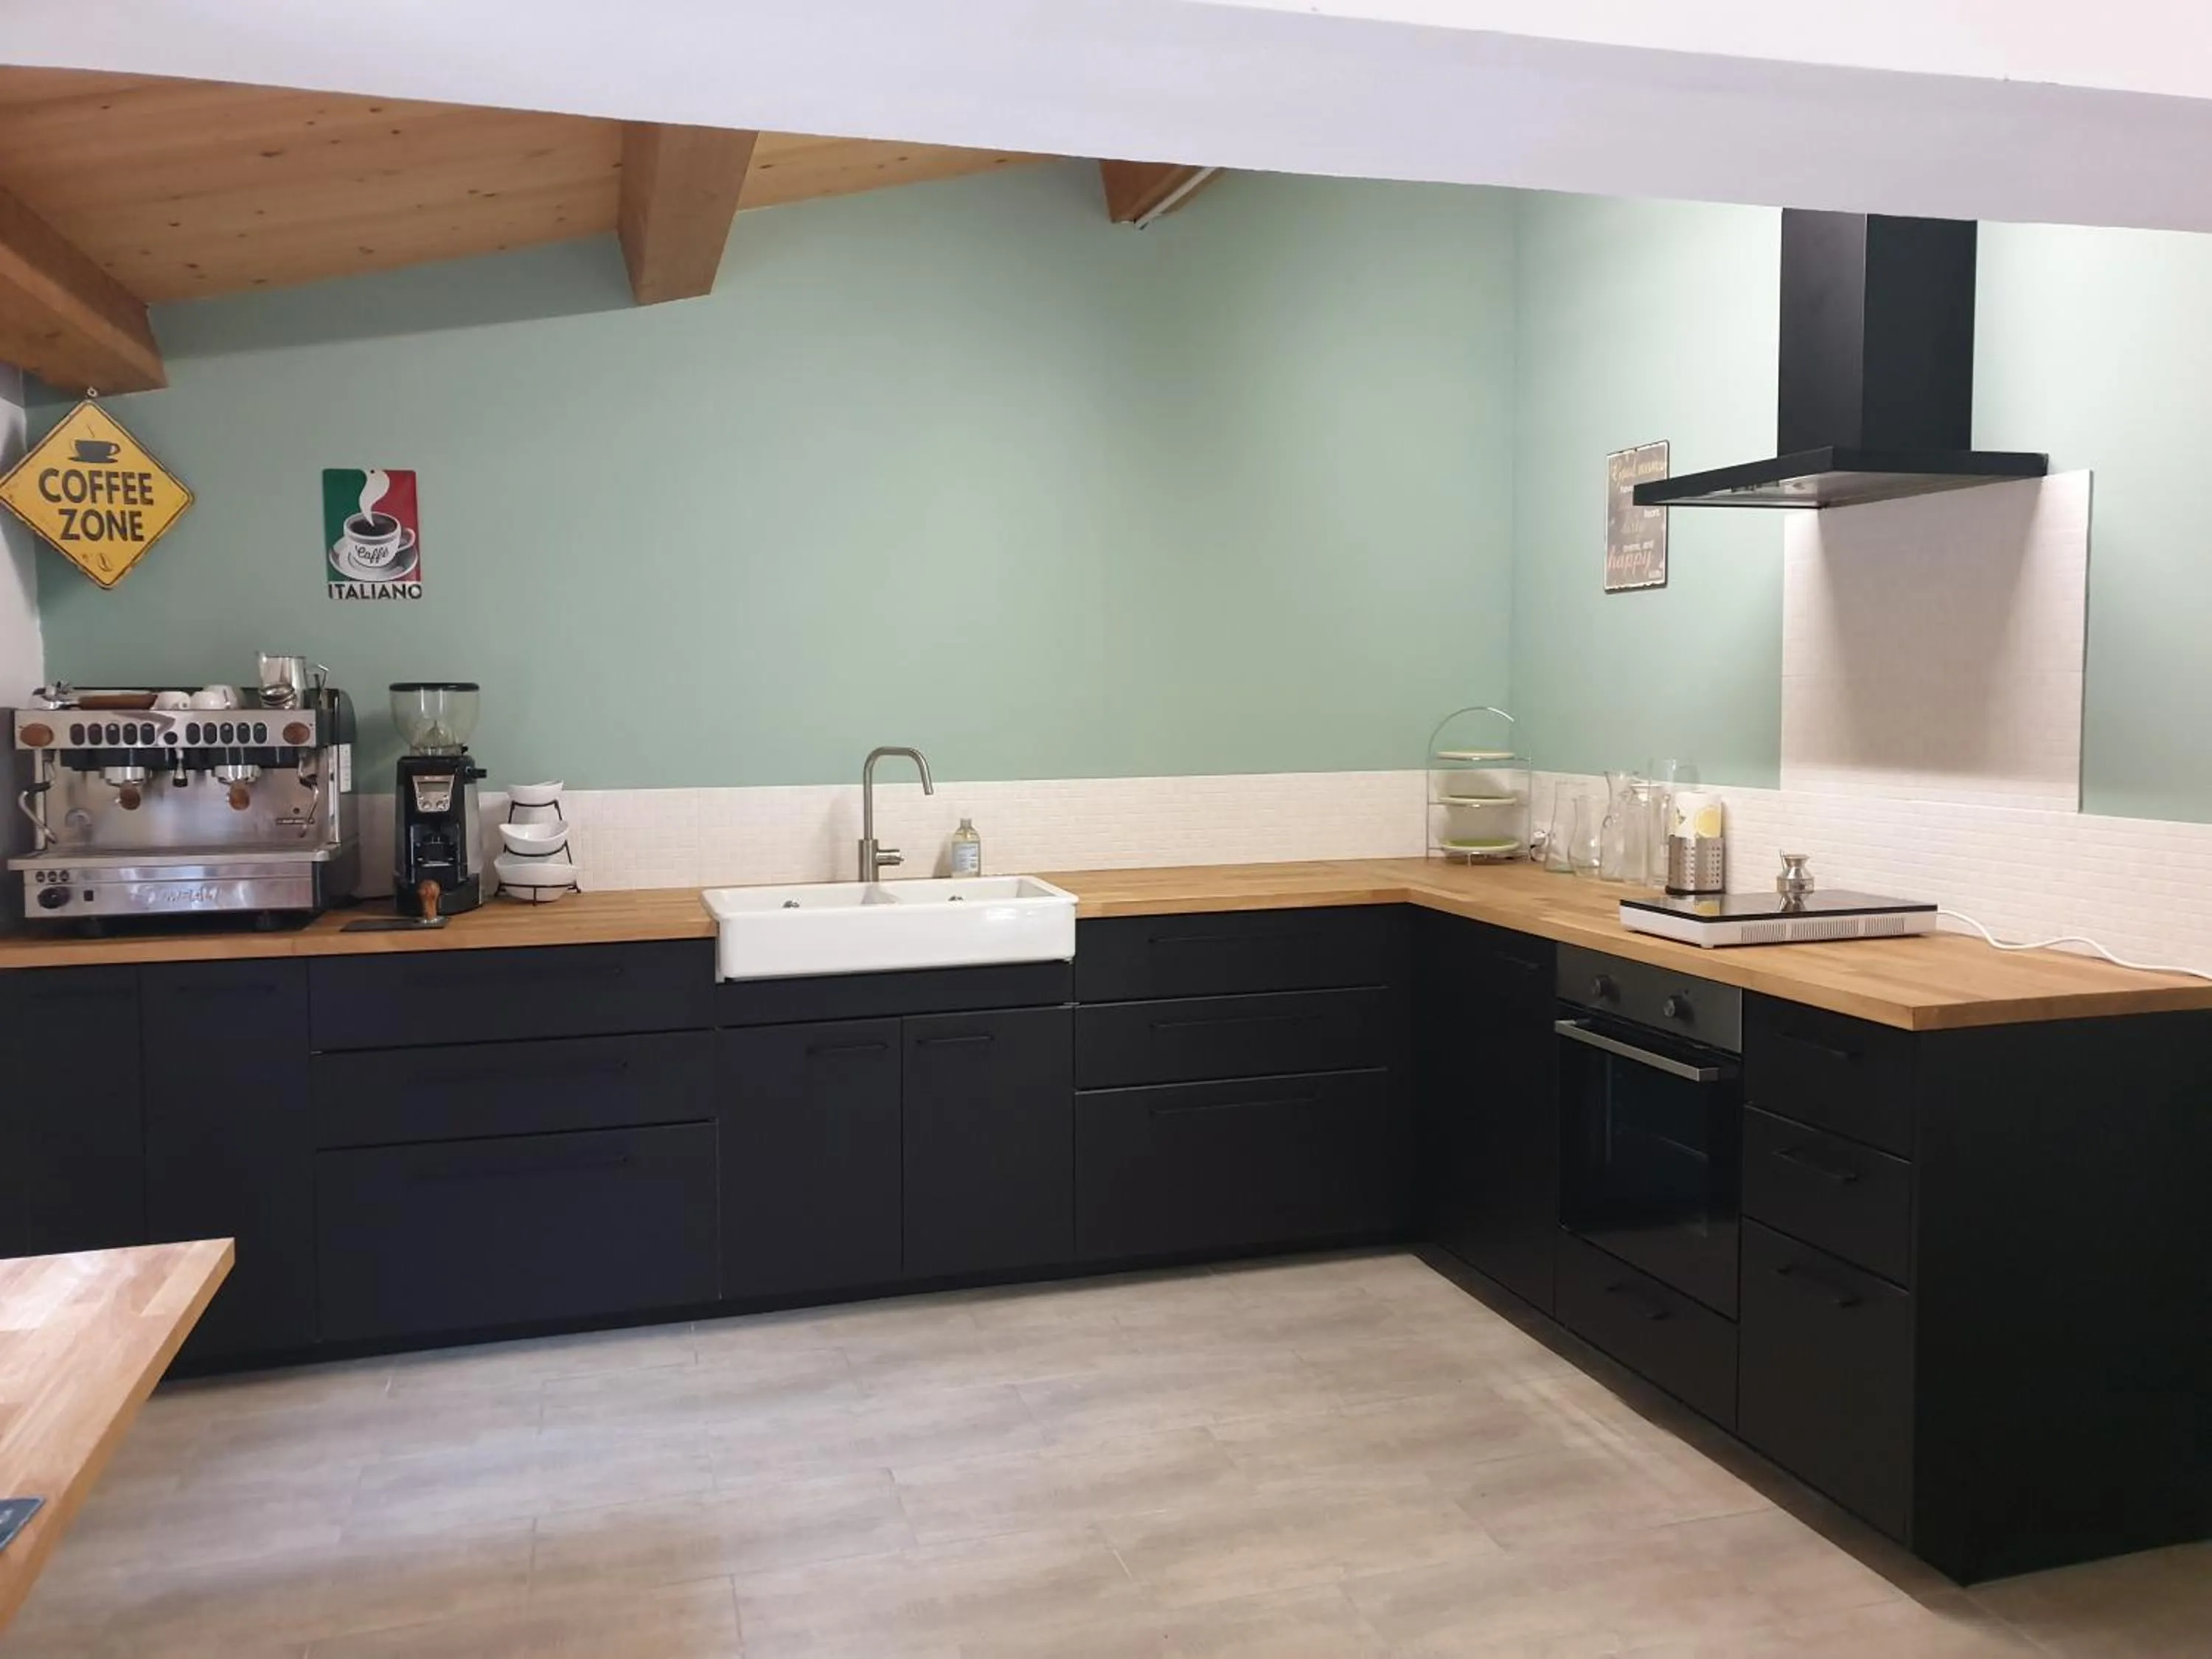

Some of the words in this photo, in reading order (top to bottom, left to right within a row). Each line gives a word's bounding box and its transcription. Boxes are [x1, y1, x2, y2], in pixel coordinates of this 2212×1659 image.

[38, 467, 154, 506] COFFEE
[58, 508, 145, 541] ZONE
[328, 583, 422, 599] ITALIANO
